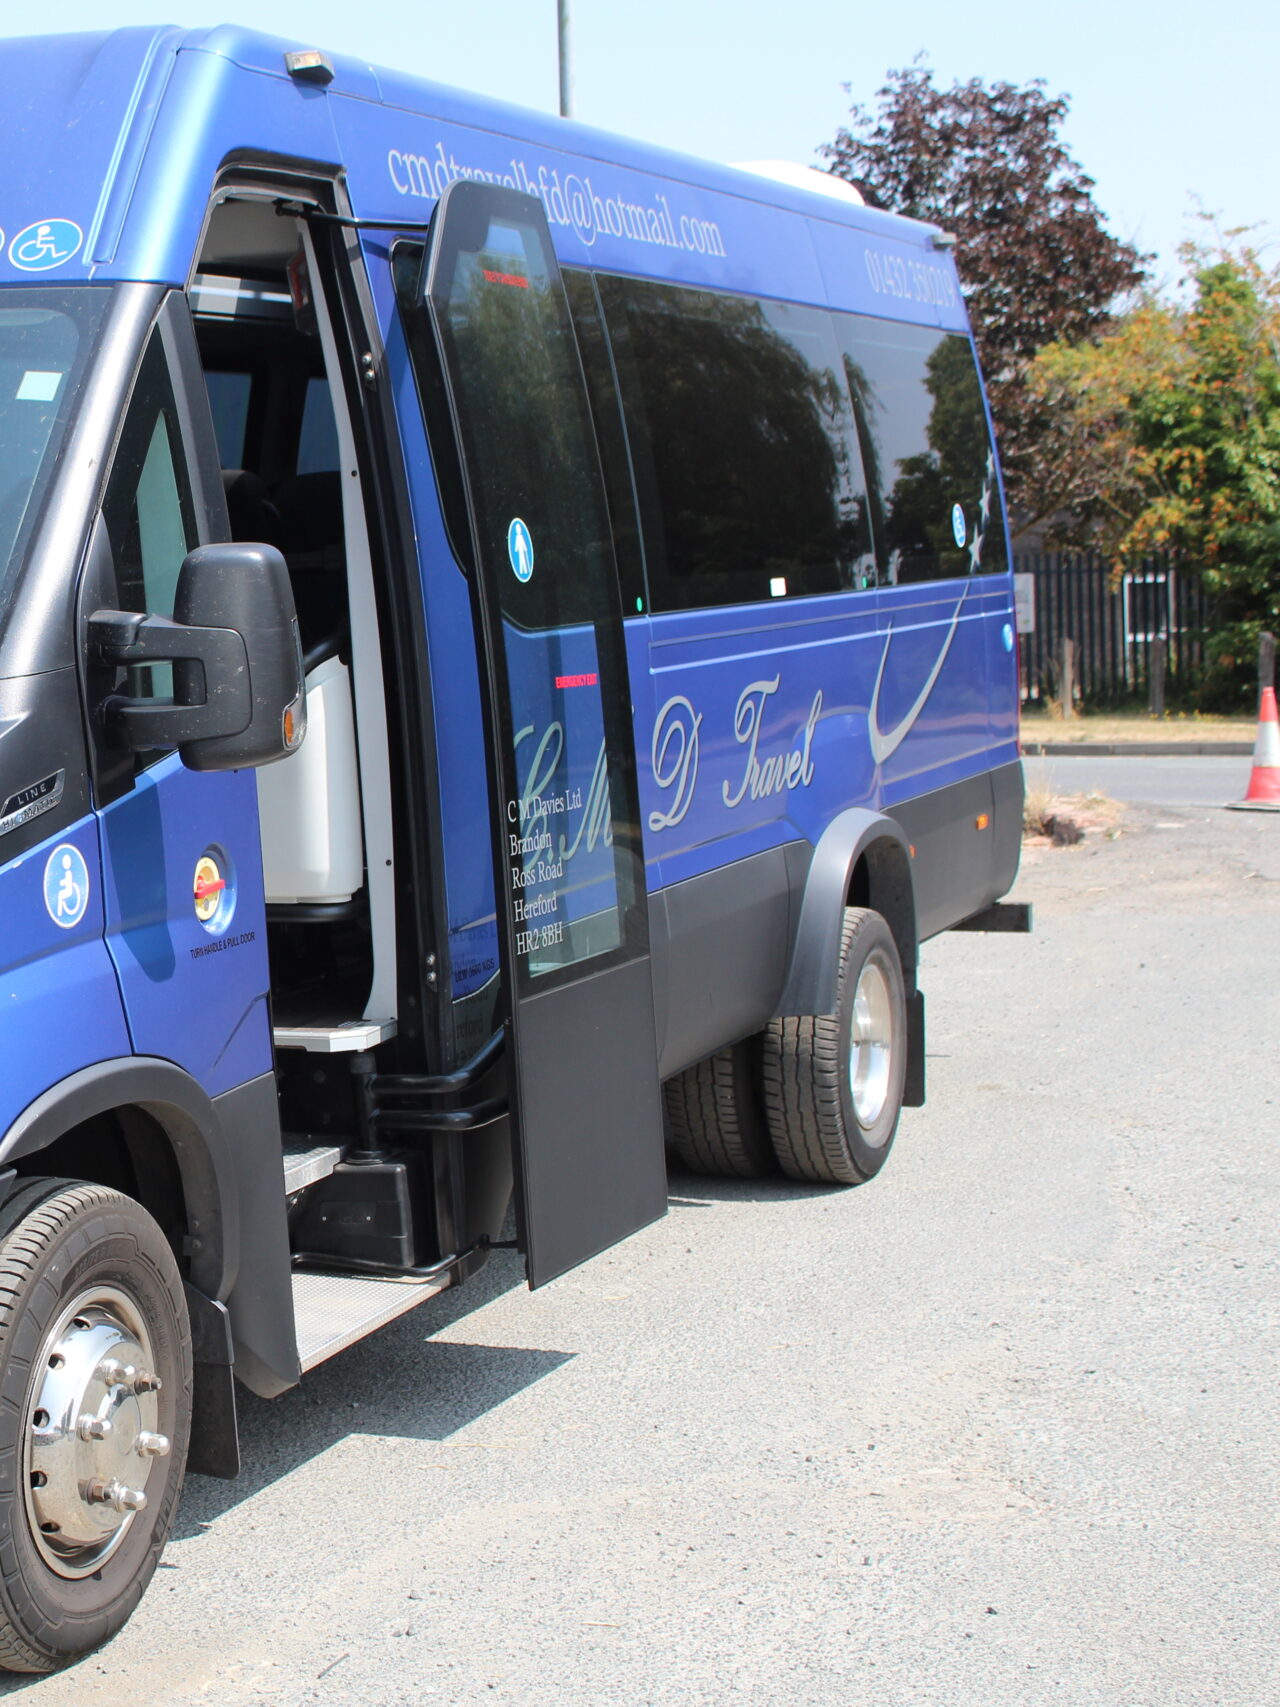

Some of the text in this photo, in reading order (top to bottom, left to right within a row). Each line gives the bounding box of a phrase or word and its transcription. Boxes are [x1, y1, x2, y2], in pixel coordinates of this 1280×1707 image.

[648, 695, 703, 832] D
[722, 672, 823, 808] Travel
[17, 783, 47, 805] LINE
[507, 787, 582, 823] C M Davies Ltd
[509, 828, 553, 857] Brandon
[512, 856, 563, 890] Ross Road
[513, 890, 558, 923] Hereford
[190, 946, 204, 959] TURN
[204, 940, 223, 955] HANDLE
[227, 936, 240, 949] PULL
[240, 931, 256, 944] DOOR
[516, 929, 540, 956] HR2
[540, 921, 564, 948] 8BH
